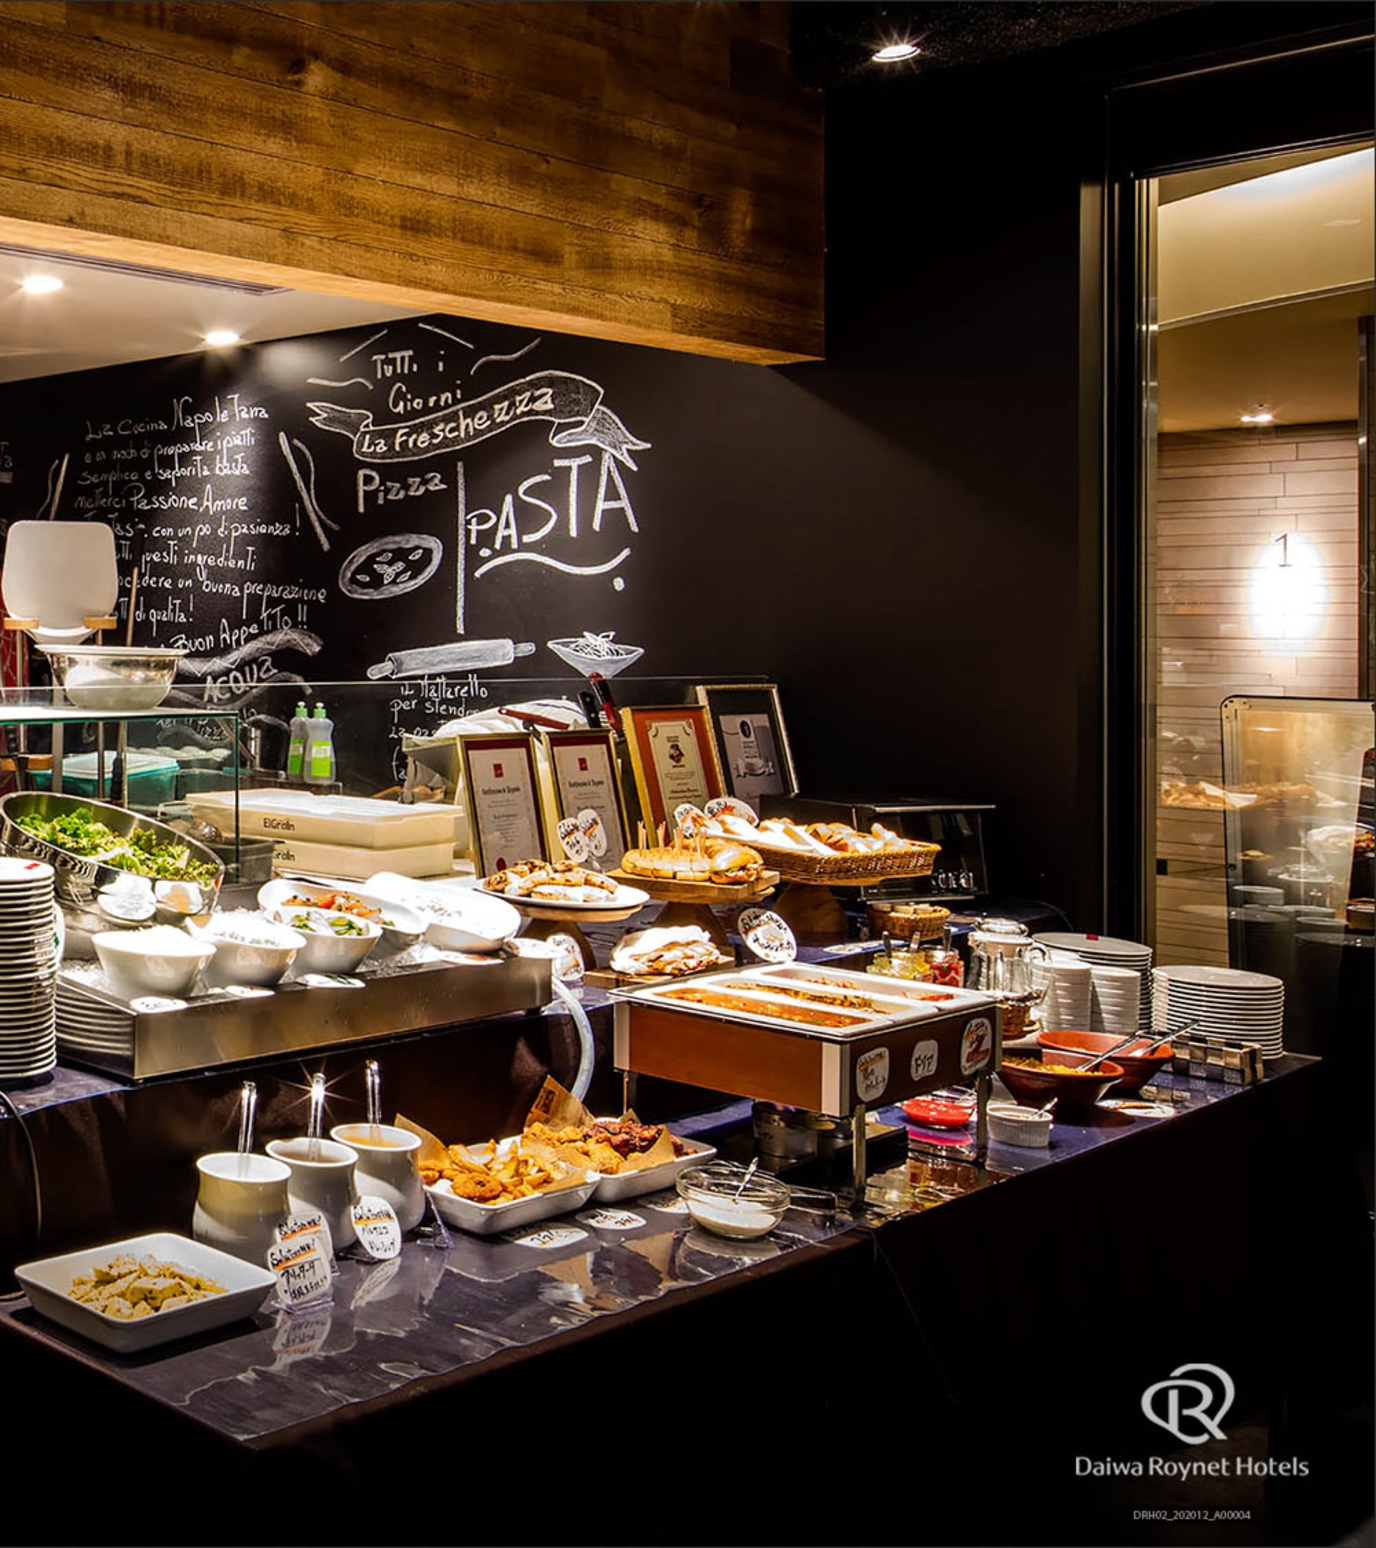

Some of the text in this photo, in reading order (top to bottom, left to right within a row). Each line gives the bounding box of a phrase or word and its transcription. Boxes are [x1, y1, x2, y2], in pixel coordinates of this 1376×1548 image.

[388, 381, 462, 414] Giorni
[360, 387, 555, 454] La Freschezza
[200, 484, 249, 516] Amore
[356, 466, 448, 514] Pizza
[465, 449, 640, 550] PASTA
[152, 524, 174, 537] con
[1274, 532, 1293, 568] 1
[388, 698, 419, 724] per
